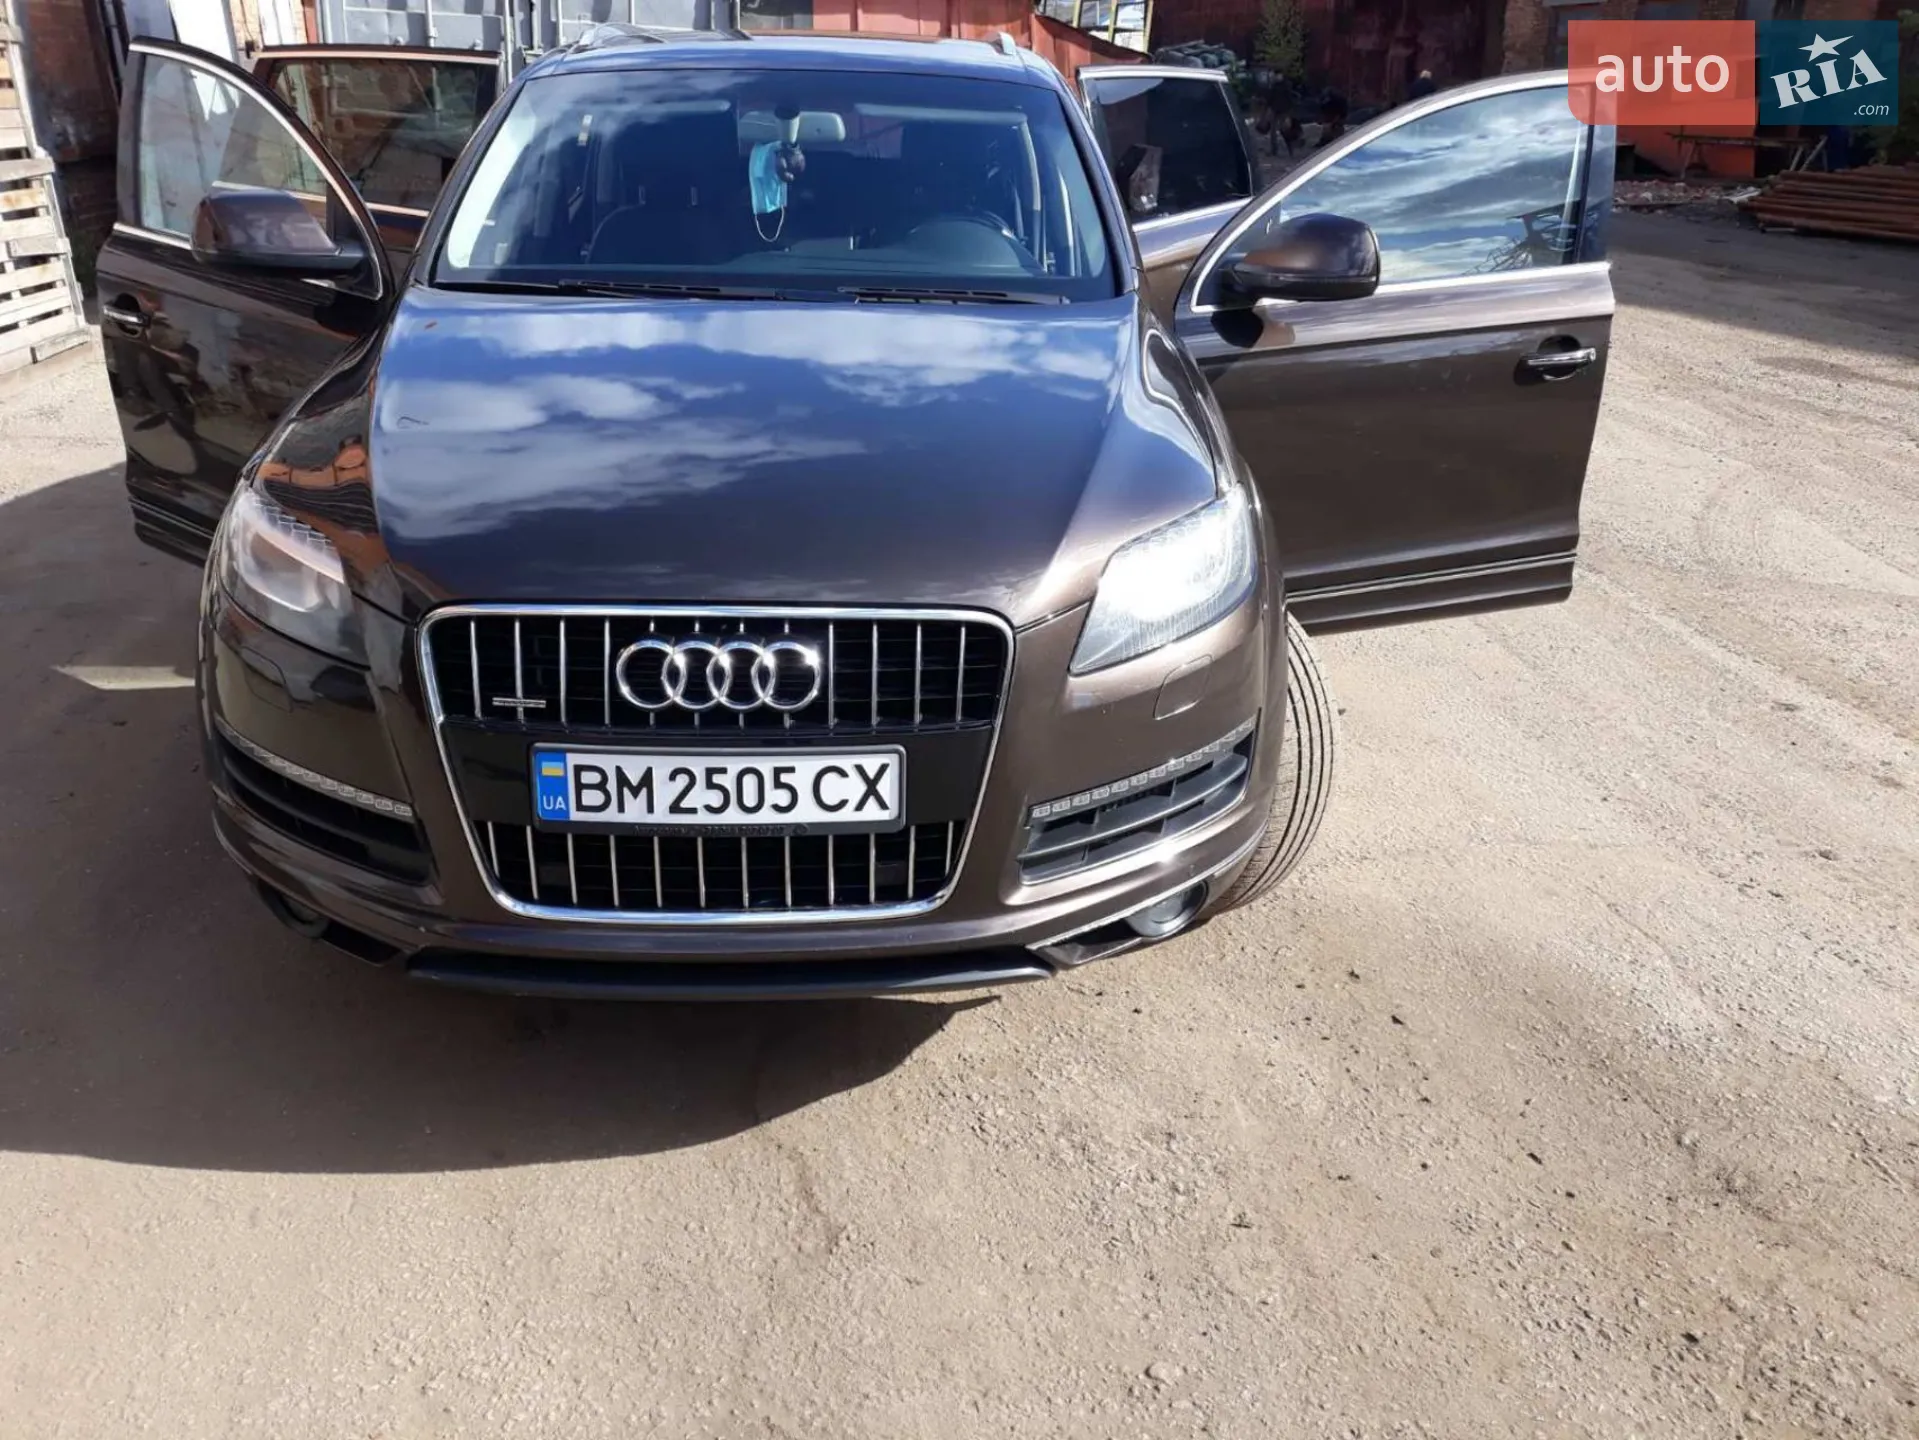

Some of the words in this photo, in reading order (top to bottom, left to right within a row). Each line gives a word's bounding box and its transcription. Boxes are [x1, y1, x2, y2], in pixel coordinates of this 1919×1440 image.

[543, 795, 566, 811] UA
[574, 764, 655, 814] BM
[668, 766, 799, 814] 2505
[812, 763, 890, 812] CX
